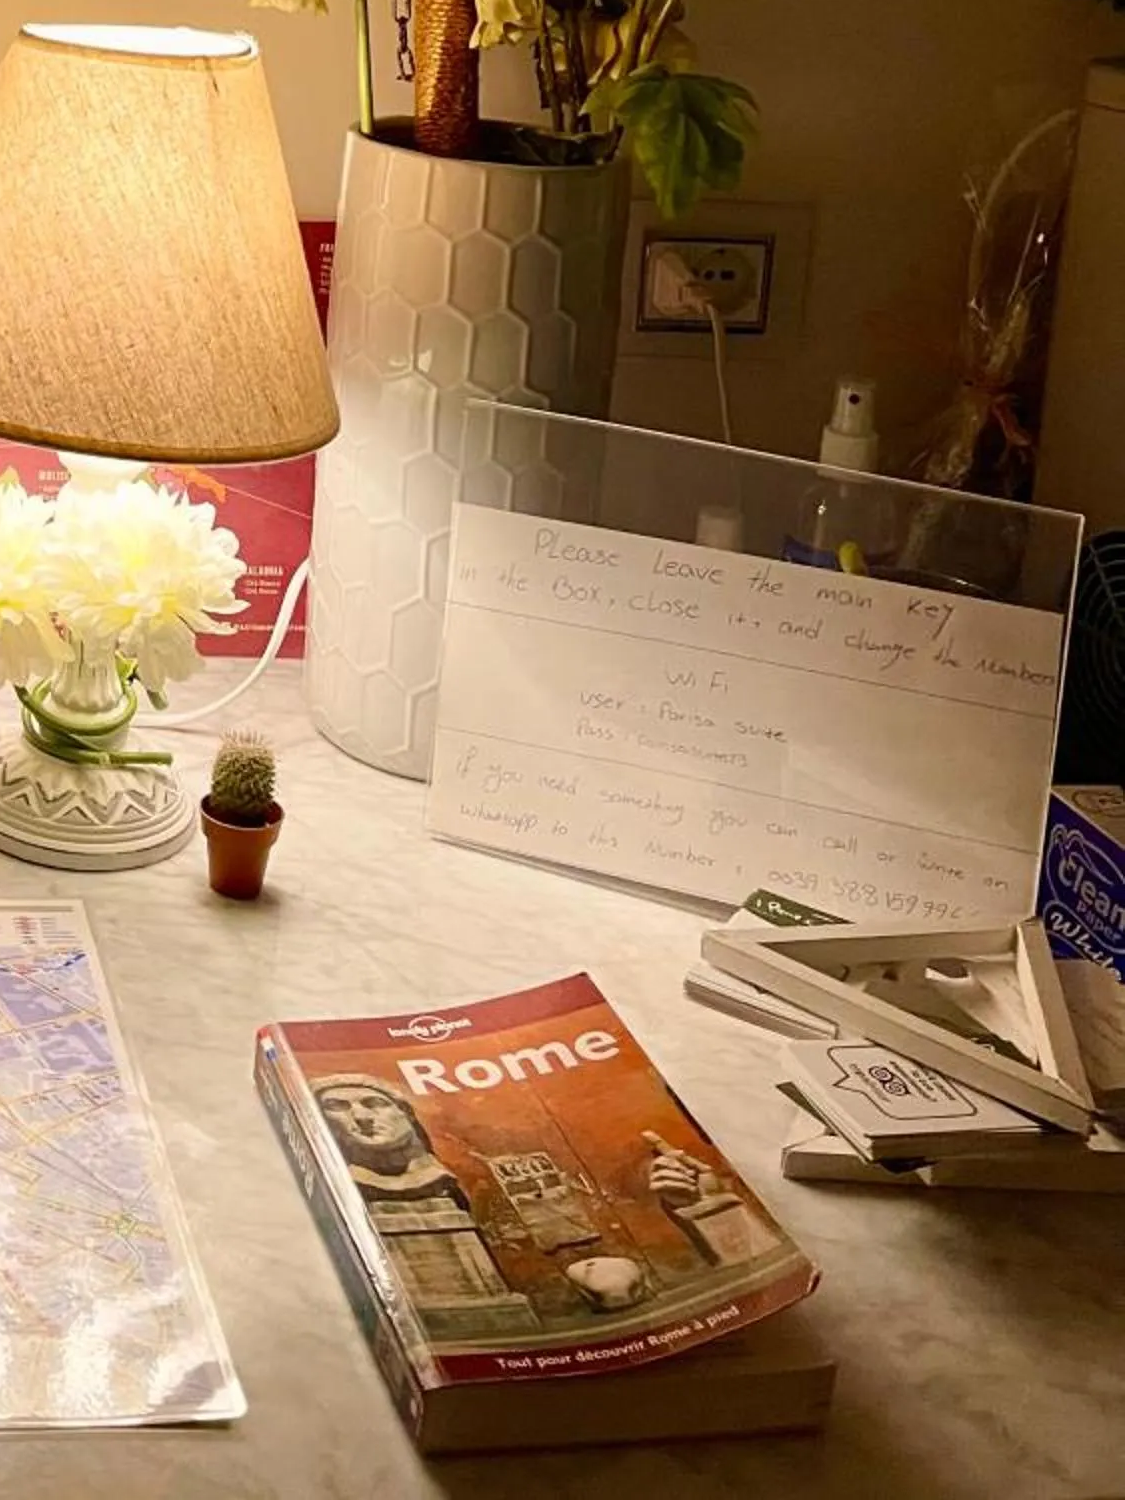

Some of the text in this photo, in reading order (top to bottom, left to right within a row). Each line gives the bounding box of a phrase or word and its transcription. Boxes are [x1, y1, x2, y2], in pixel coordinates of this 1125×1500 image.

[496, 563, 529, 592] the
[778, 618, 824, 640] and
[746, 564, 784, 597] the
[816, 587, 873, 610] main
[823, 835, 859, 855] call
[395, 1027, 621, 1097] Rome
[535, 1353, 573, 1371] pour
[574, 1340, 645, 1363] découvrir
[646, 1326, 693, 1347] Rome
[705, 1304, 741, 1329] pied
